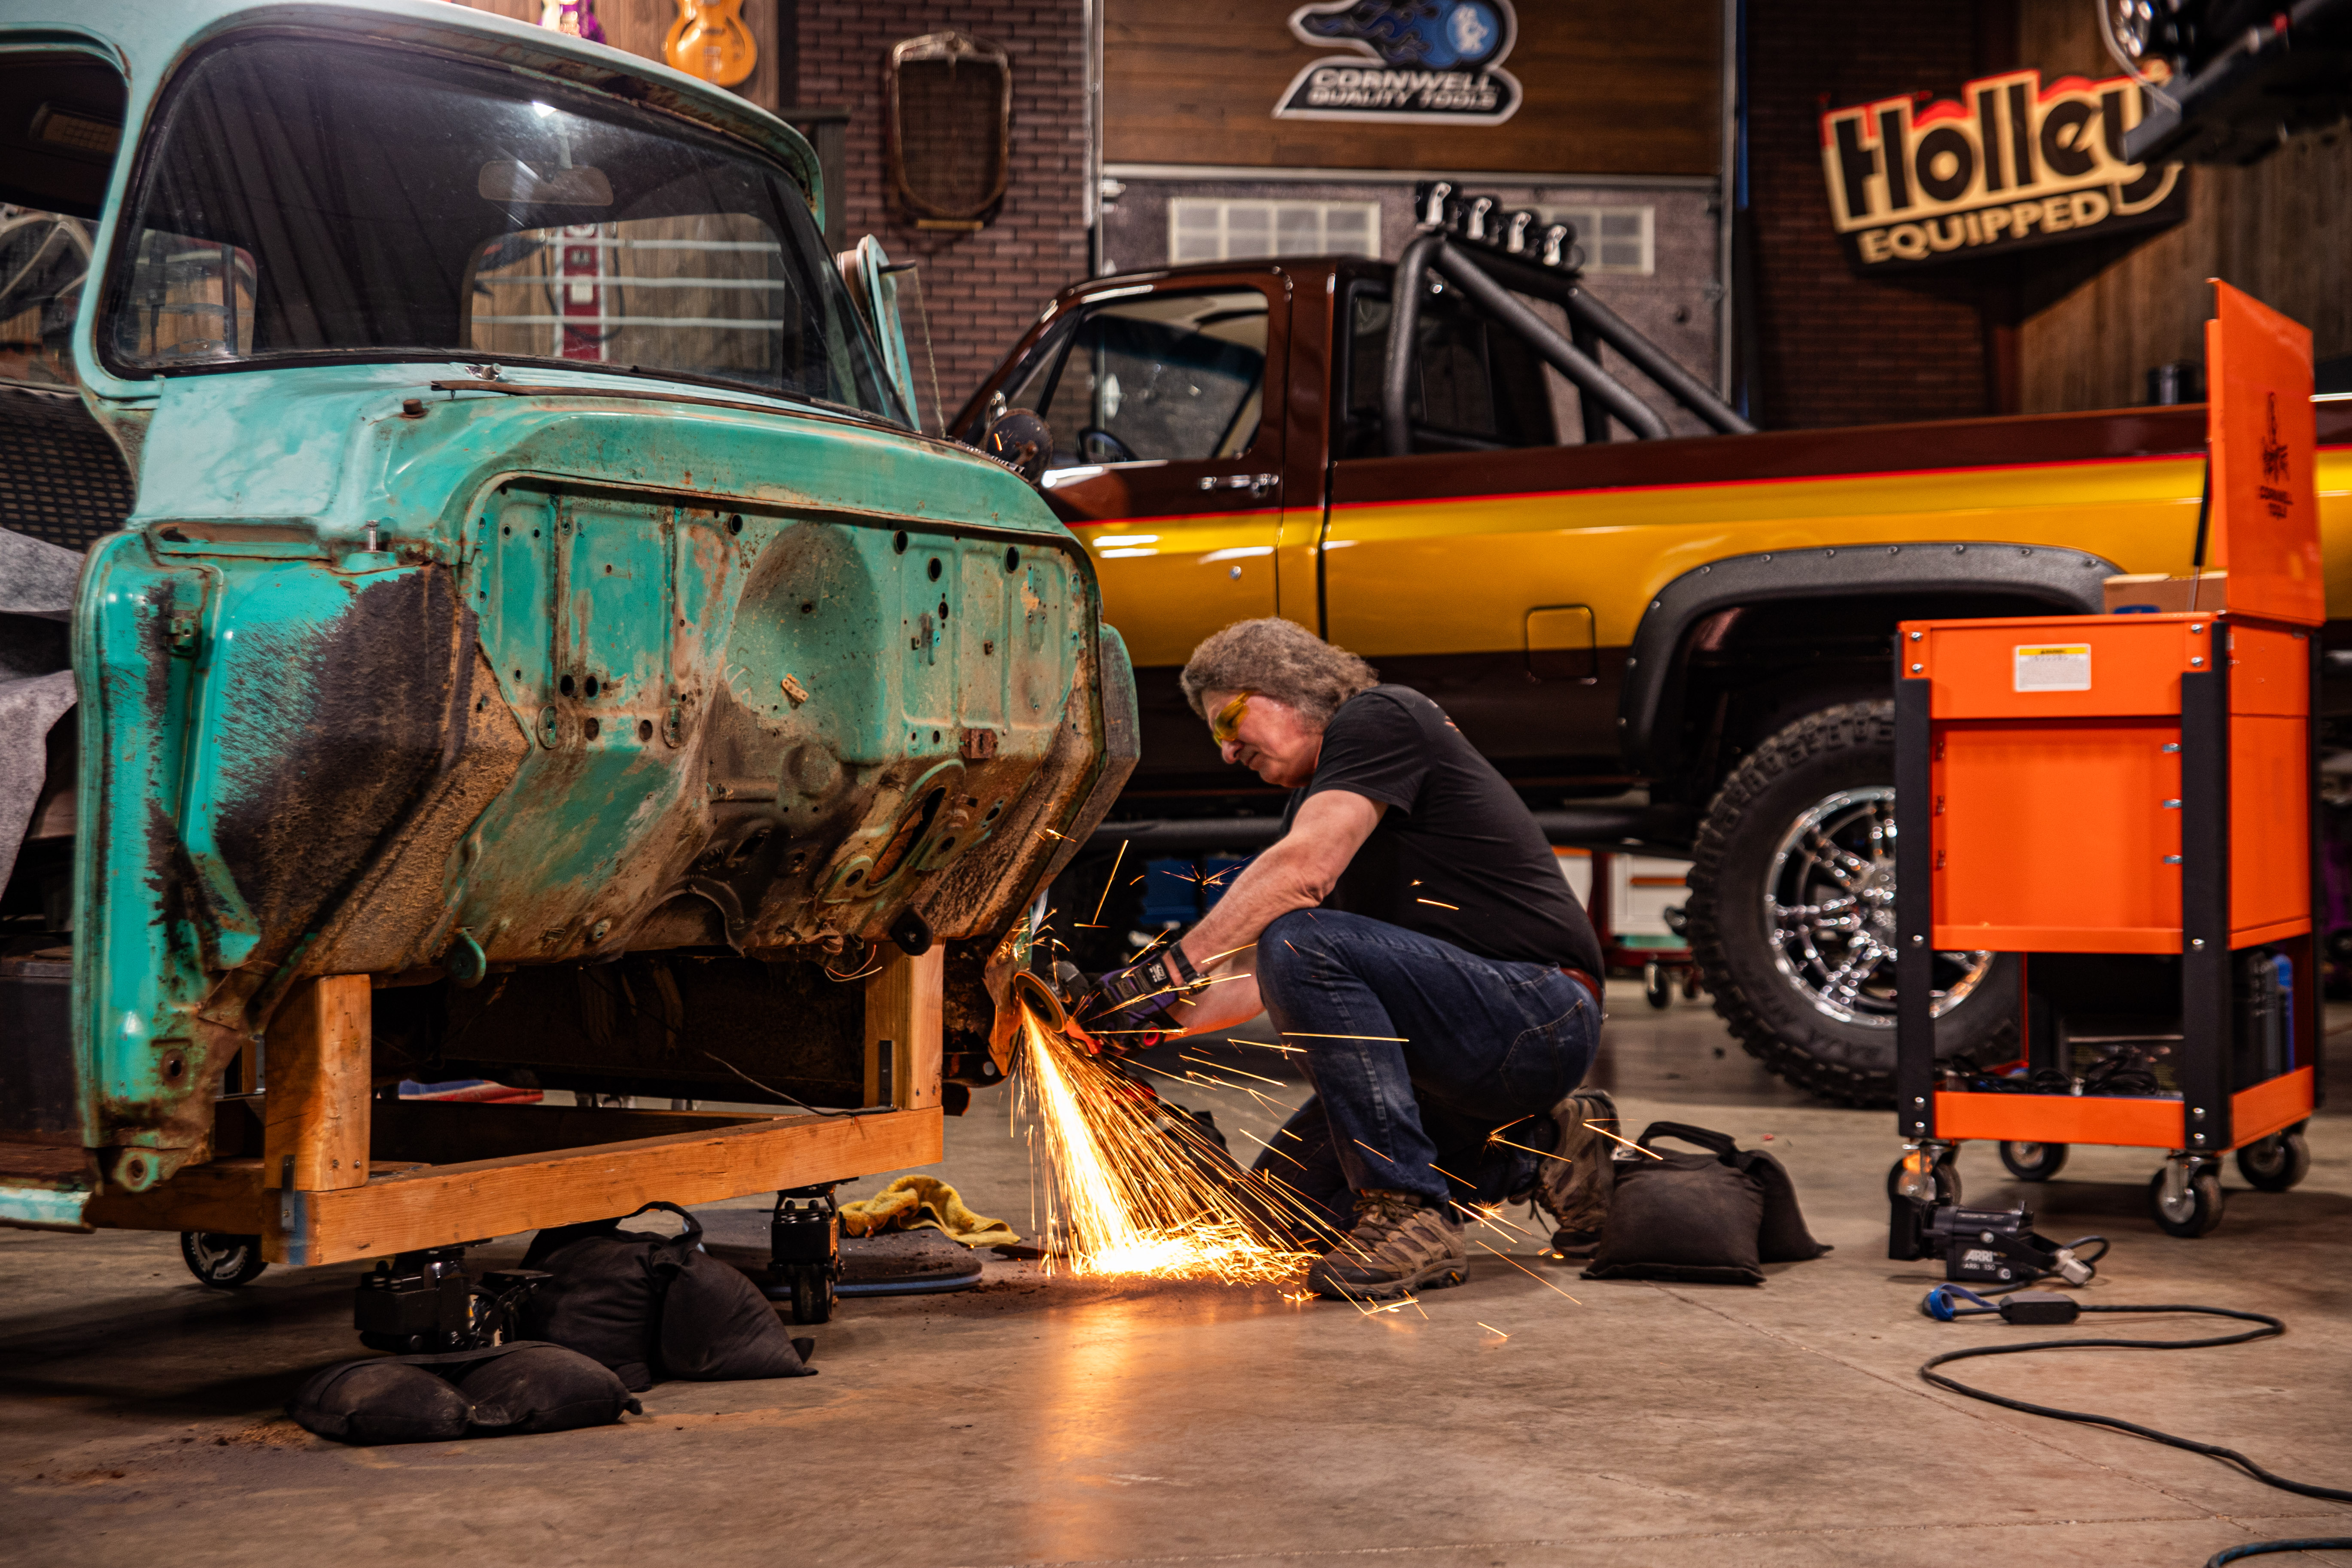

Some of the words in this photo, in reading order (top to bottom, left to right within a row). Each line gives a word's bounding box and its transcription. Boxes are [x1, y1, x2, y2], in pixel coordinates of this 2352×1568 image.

[1311, 68, 1492, 90] CORNWELL
[1307, 87, 1412, 107] QUALITY
[1417, 88, 1497, 110] TOOLS
[1857, 190, 2109, 264] EQUIPPED
[1965, 1248, 1993, 1262] ARRI
